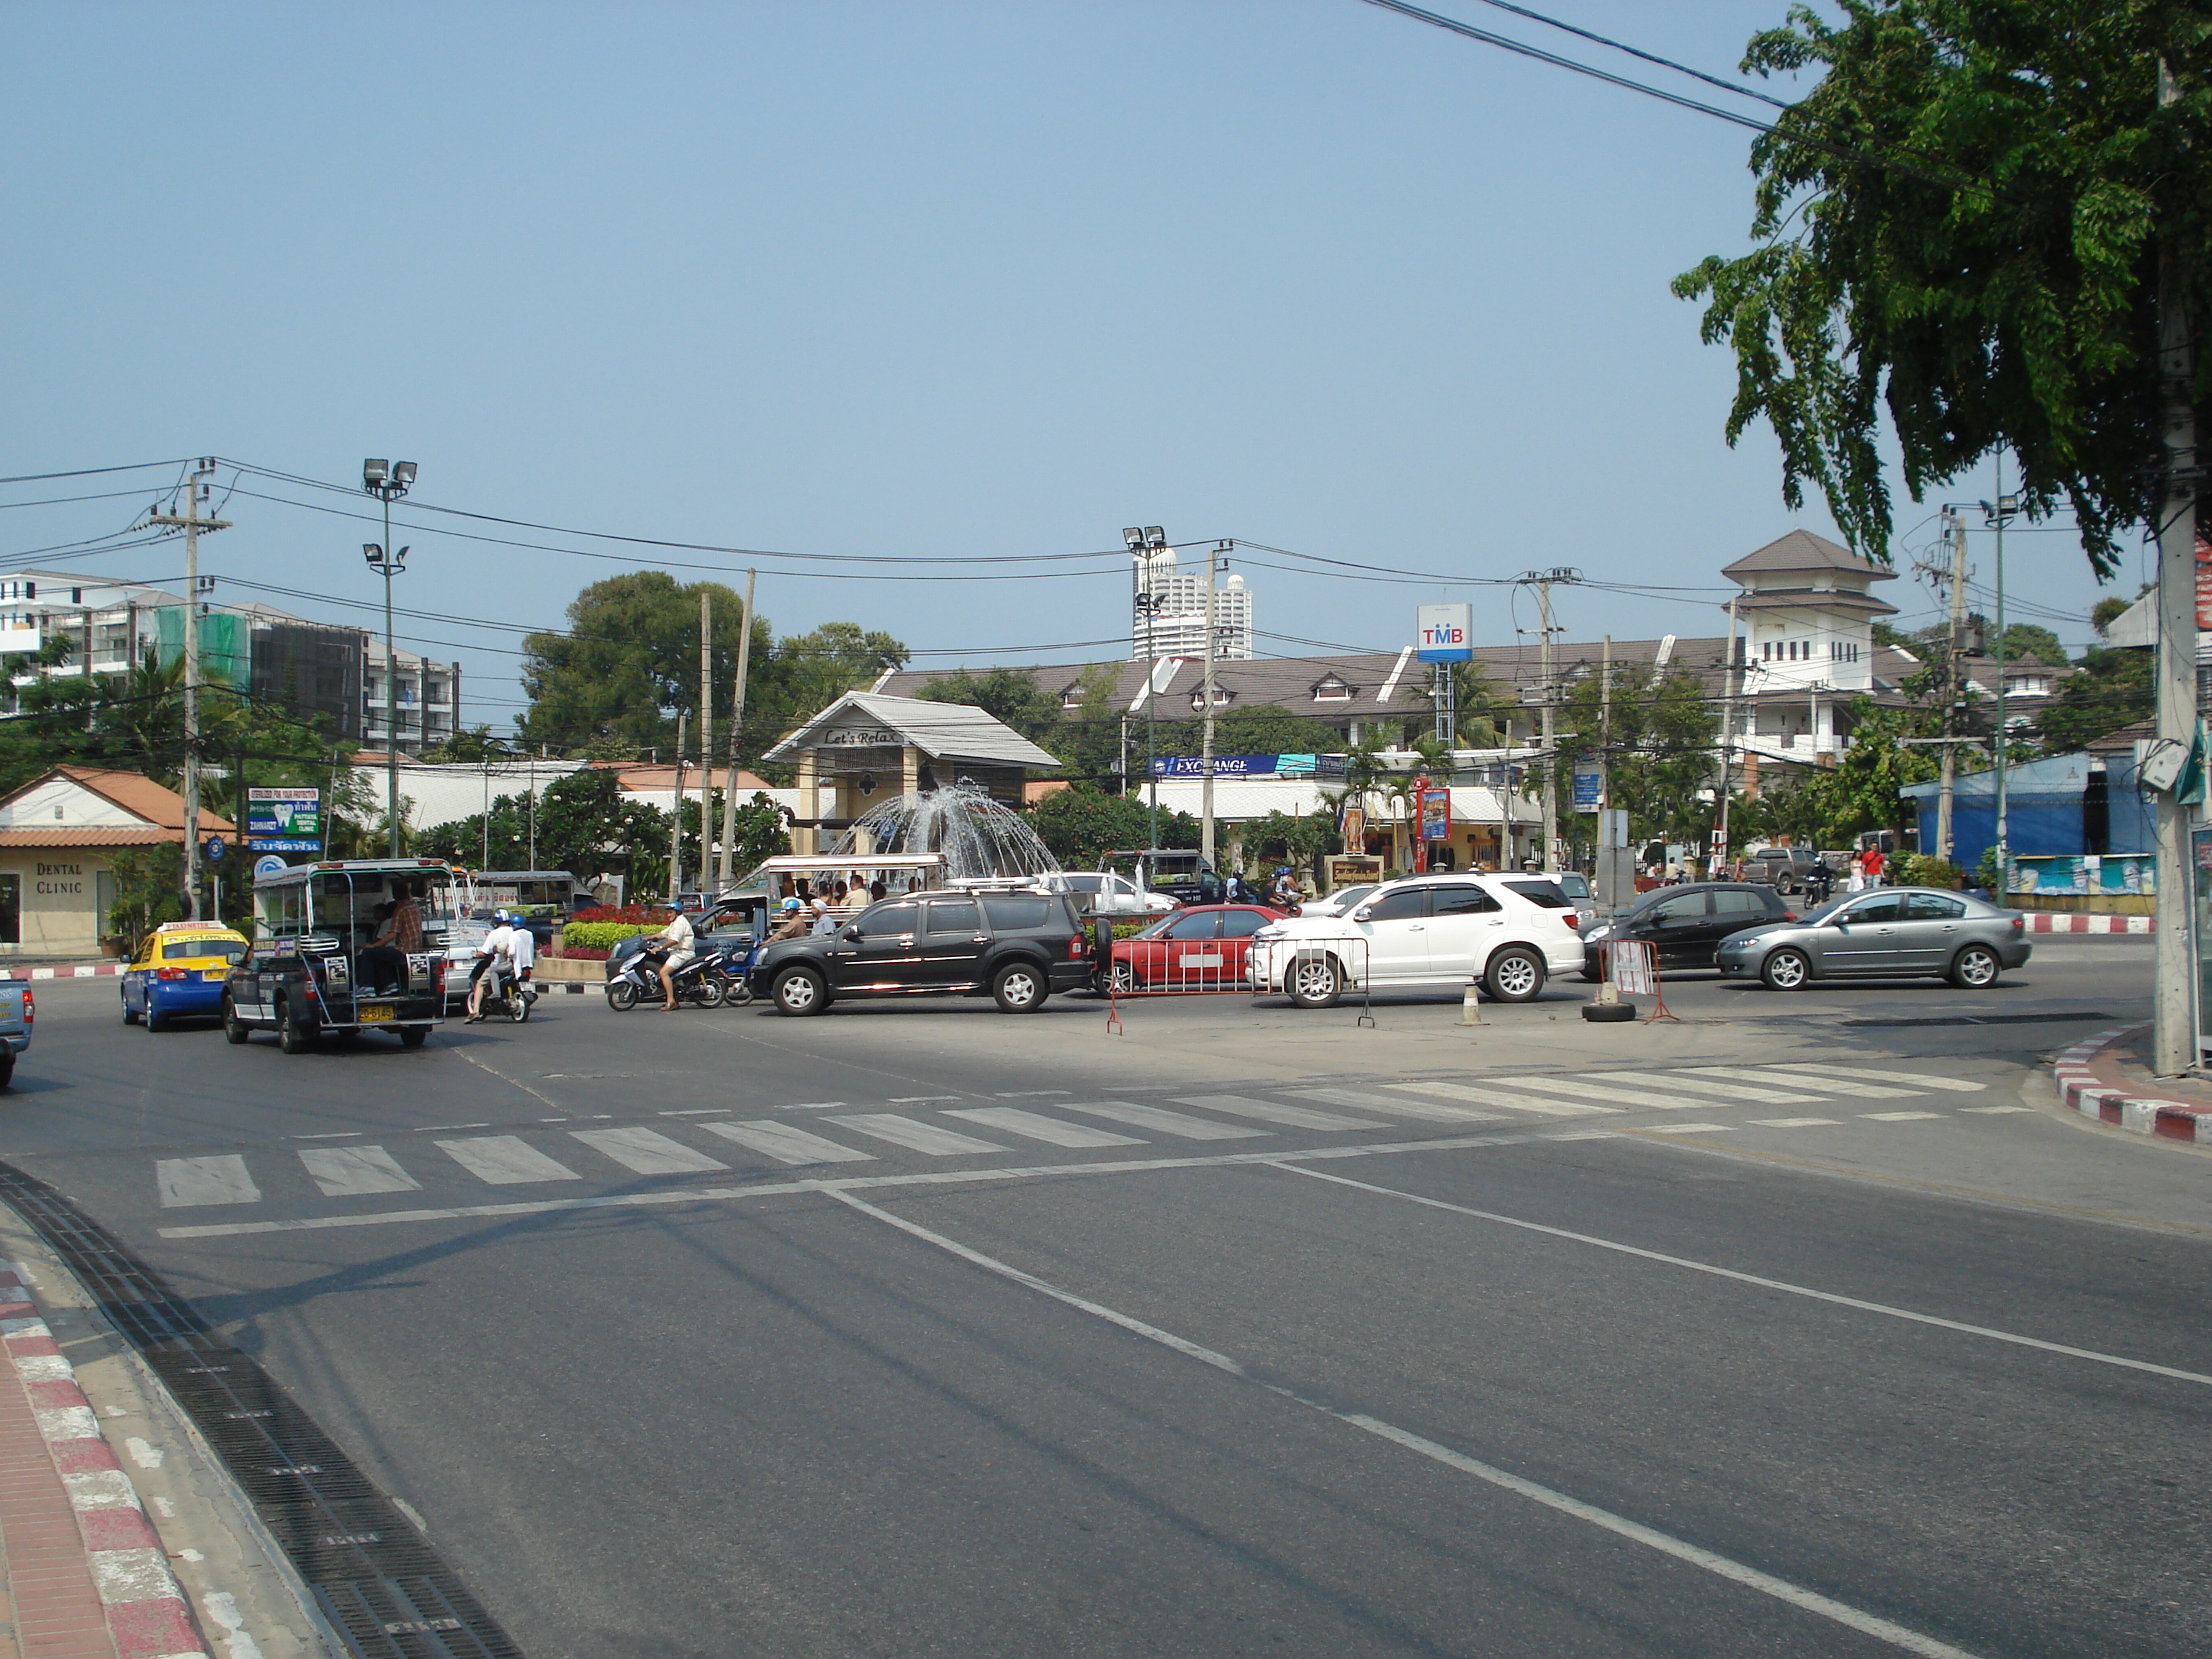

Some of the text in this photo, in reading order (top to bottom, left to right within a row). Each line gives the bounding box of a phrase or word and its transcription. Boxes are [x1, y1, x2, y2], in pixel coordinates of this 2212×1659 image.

[1423, 624, 1462, 644] TMB
[824, 730, 899, 744] Let's Relax
[1177, 760, 1247, 772] EXCANGE
[37, 863, 82, 875] DENTAL
[37, 881, 81, 894] CLINIC
